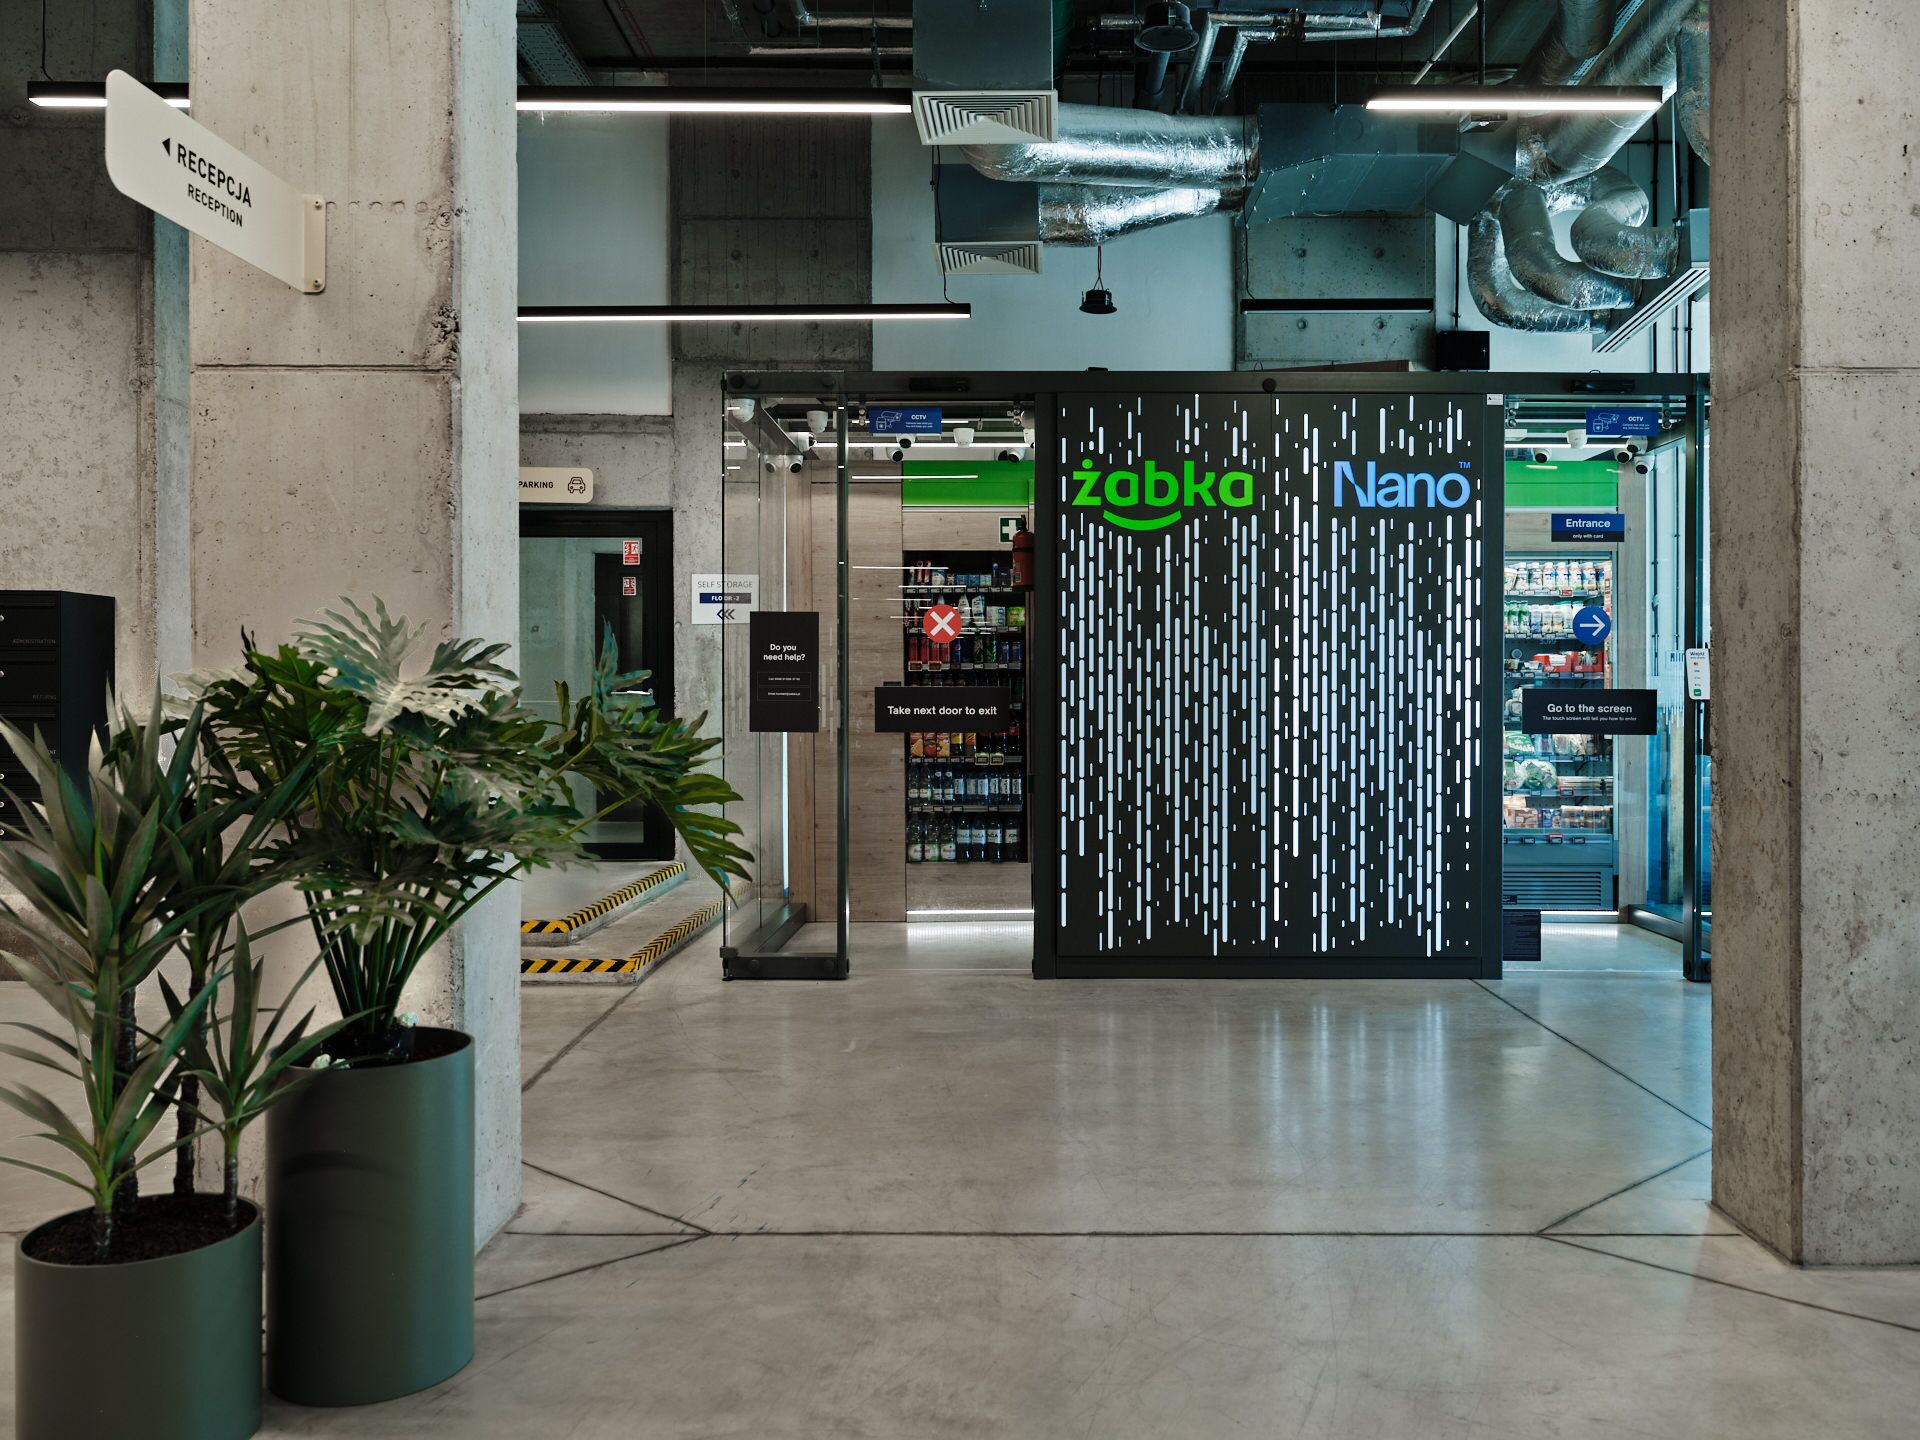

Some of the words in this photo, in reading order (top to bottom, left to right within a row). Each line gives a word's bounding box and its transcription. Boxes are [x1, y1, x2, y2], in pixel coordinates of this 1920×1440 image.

[177, 143, 252, 208] RECEPCJA
[188, 183, 243, 228] RECEPTION
[519, 481, 554, 489] PARKING
[1072, 458, 1254, 507] żabka
[1333, 460, 1471, 509] Nano
[1565, 518, 1611, 528] Entrance
[770, 643, 781, 651] Do
[782, 645, 797, 653] you
[763, 653, 783, 661] need
[784, 653, 806, 662] help?
[888, 706, 912, 715] Take
[913, 706, 937, 715] next
[938, 706, 963, 715] door
[965, 706, 976, 715] to
[978, 706, 997, 715] exit
[1547, 703, 1563, 713] Go
[1565, 703, 1576, 713] to
[1578, 703, 1595, 713] the
[1597, 705, 1633, 713] screen
